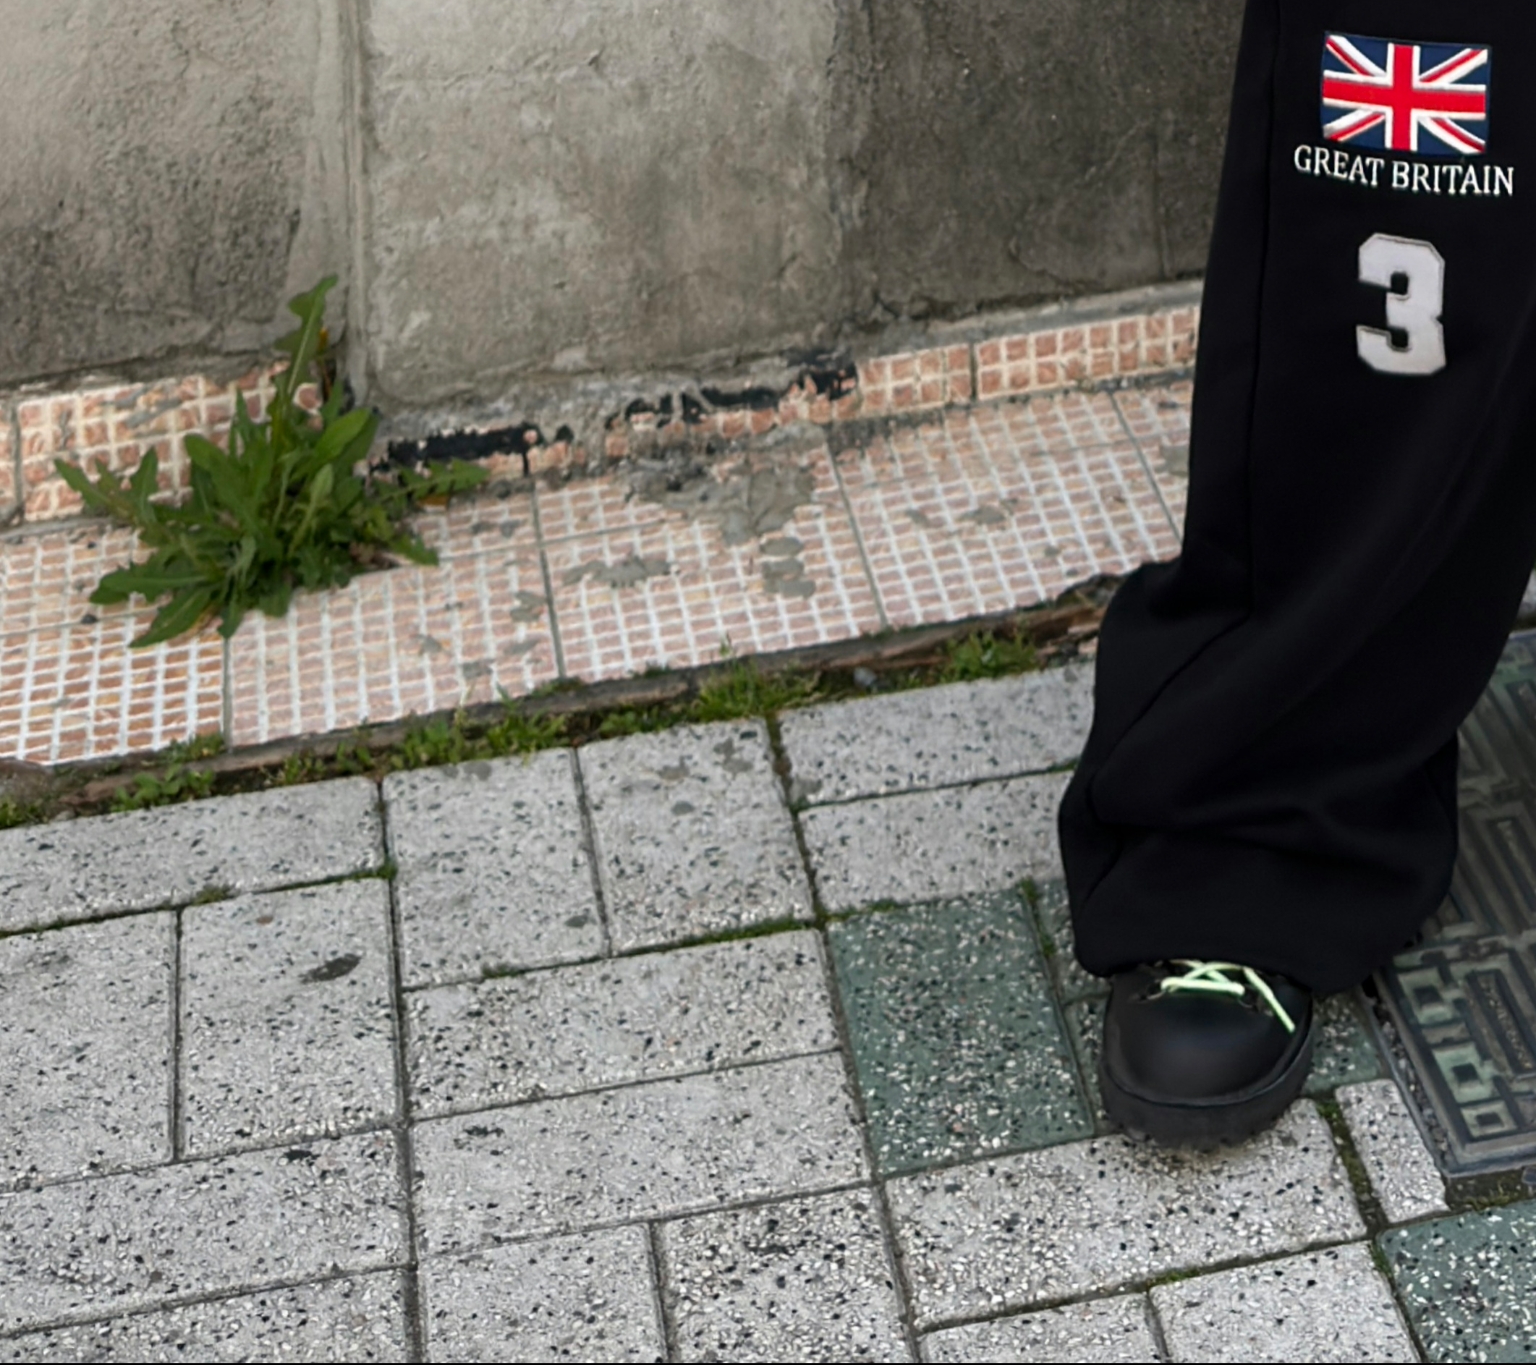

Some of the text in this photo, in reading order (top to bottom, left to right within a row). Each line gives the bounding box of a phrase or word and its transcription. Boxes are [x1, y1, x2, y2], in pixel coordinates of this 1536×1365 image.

[1294, 144, 1515, 197] GREAT BRITAIN
[1356, 232, 1446, 376] 3
